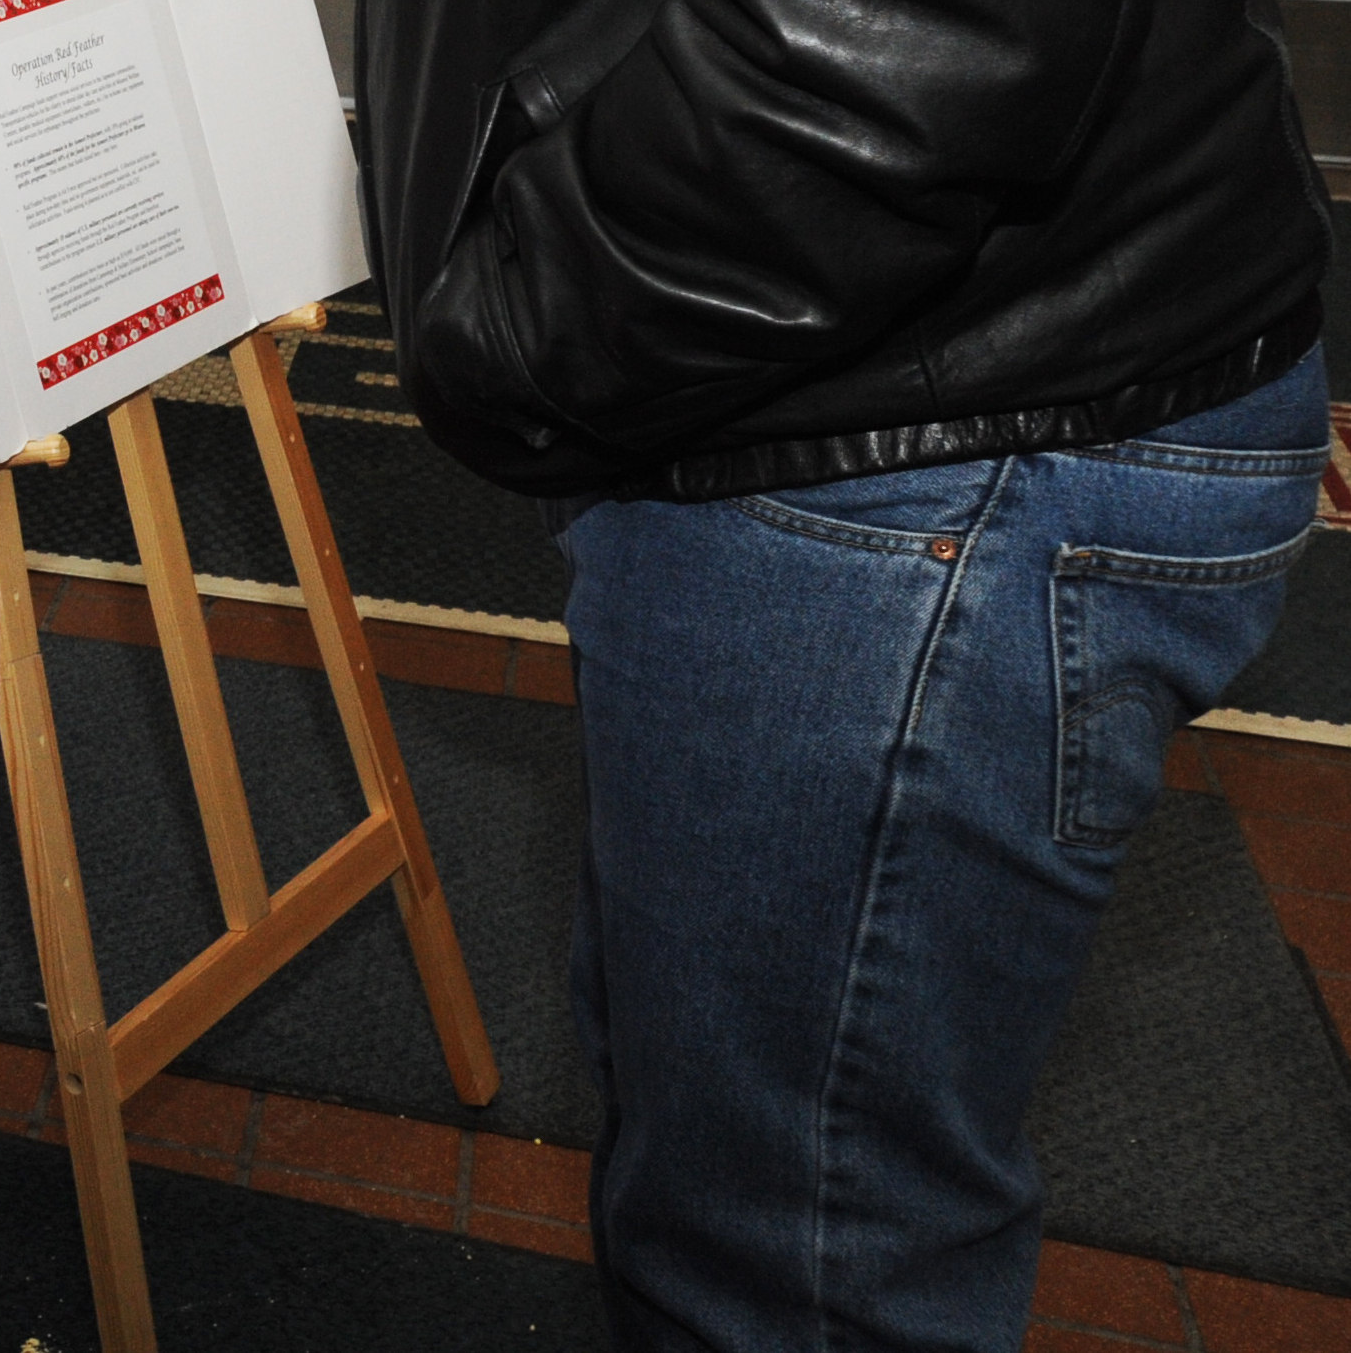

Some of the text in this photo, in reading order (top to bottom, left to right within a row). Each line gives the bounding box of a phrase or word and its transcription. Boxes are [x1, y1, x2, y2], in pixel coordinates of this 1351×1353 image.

[11, 32, 106, 81] Operation Red Feather
